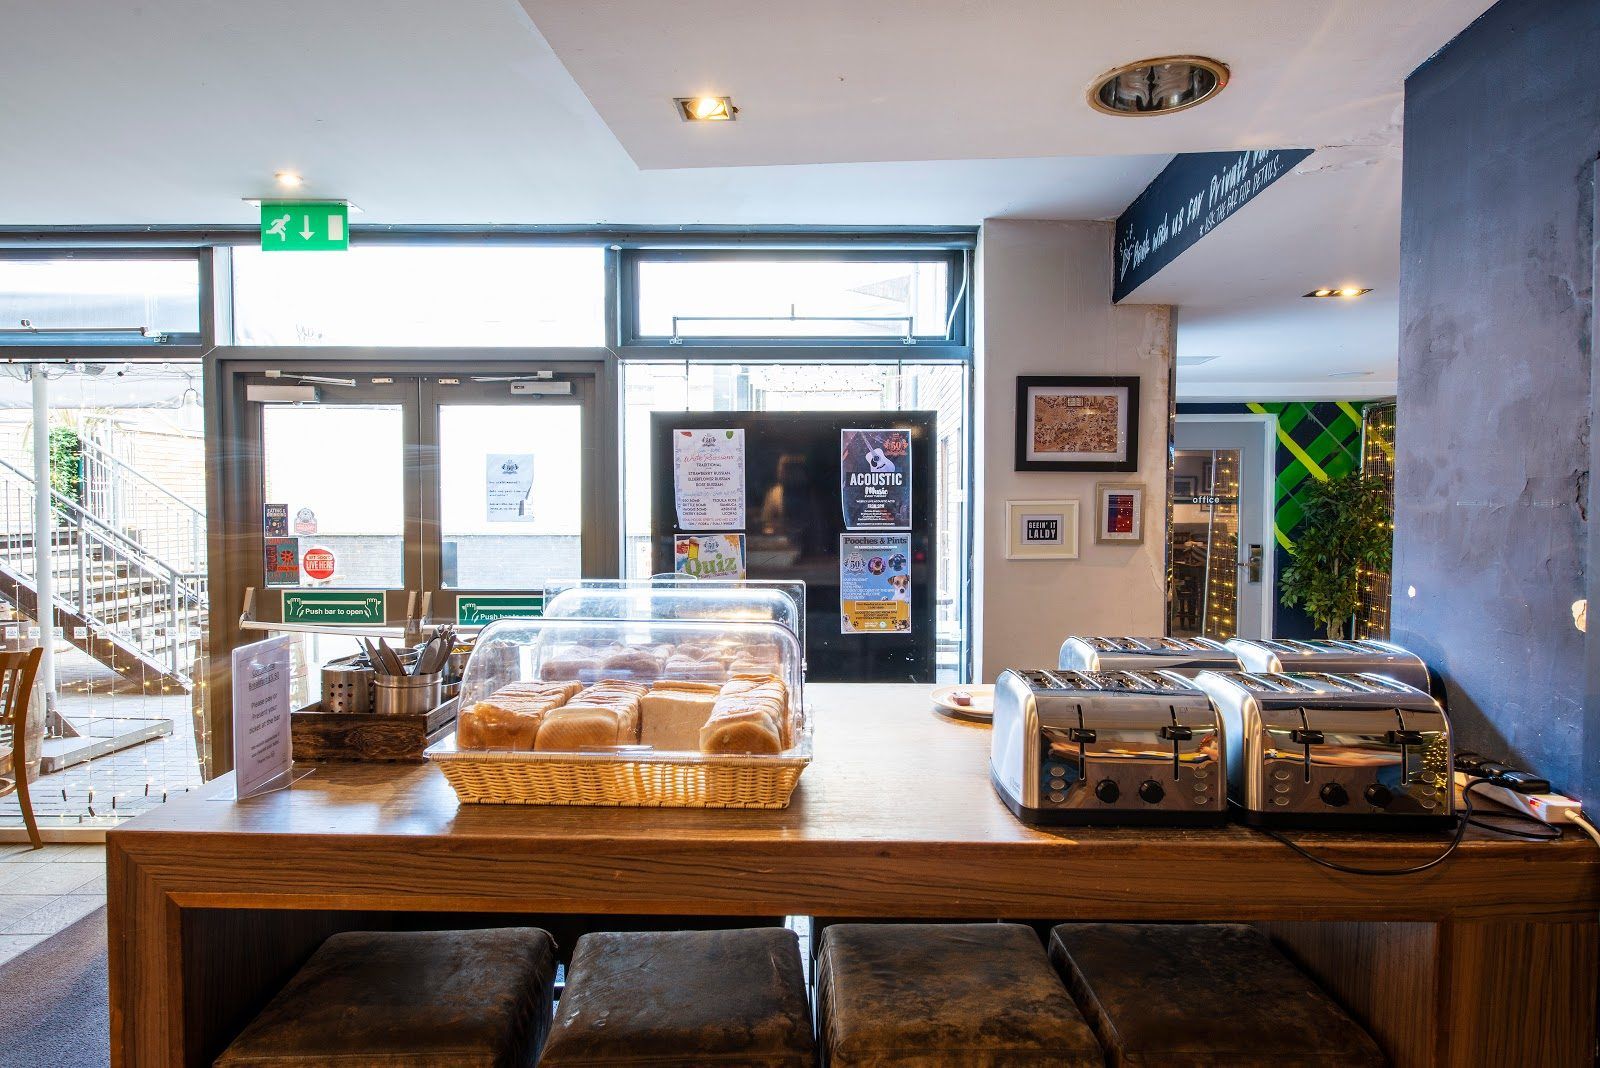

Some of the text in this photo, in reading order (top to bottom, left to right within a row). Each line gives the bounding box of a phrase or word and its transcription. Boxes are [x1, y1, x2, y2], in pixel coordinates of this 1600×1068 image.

[1133, 229, 1150, 270] Book
[1152, 212, 1168, 252] with
[1172, 206, 1184, 238] us
[850, 473, 902, 486] ACOUSTIC
[865, 486, 888, 495] Music
[1192, 496, 1220, 504] office
[1028, 529, 1056, 539] LALDY
[306, 560, 318, 570] LIVE
[319, 560, 334, 570] HERE
[685, 553, 737, 578] Quiz
[251, 698, 264, 709] Please
[252, 705, 278, 720] Present your
